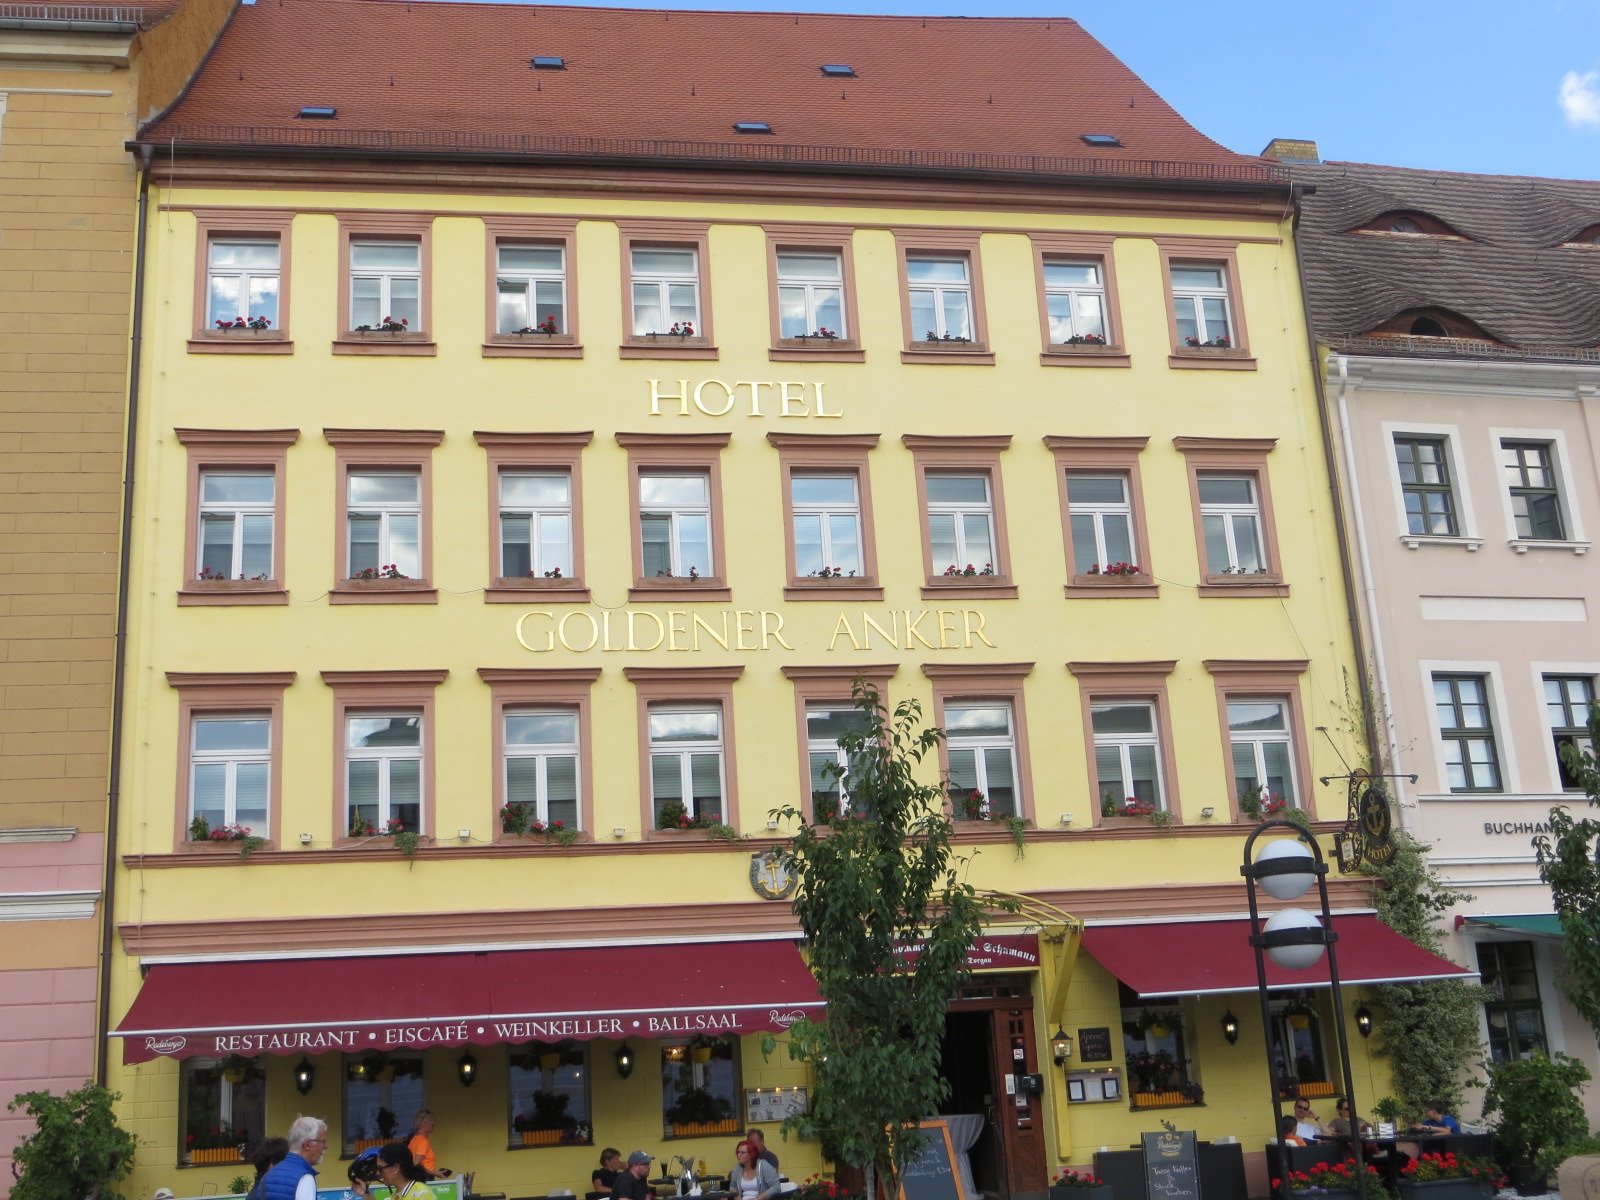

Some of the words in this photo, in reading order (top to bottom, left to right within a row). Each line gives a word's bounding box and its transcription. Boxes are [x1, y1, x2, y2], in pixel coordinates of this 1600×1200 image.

[647, 379, 844, 418] HOTEL
[515, 610, 795, 652] GOLDENER
[827, 609, 998, 650] ANKER
[1484, 822, 1554, 835] BUCHHAN
[1367, 844, 1392, 860] HOTEL
[967, 957, 992, 965] Torgau
[983, 942, 1036, 962] Schumann
[215, 1030, 359, 1051] RESTAURANT
[385, 1021, 469, 1044] EISCAFÉ
[494, 1018, 624, 1038] WEINKELLER
[648, 1013, 743, 1031] BALLSAAL
[145, 1035, 187, 1054] Radeberger
